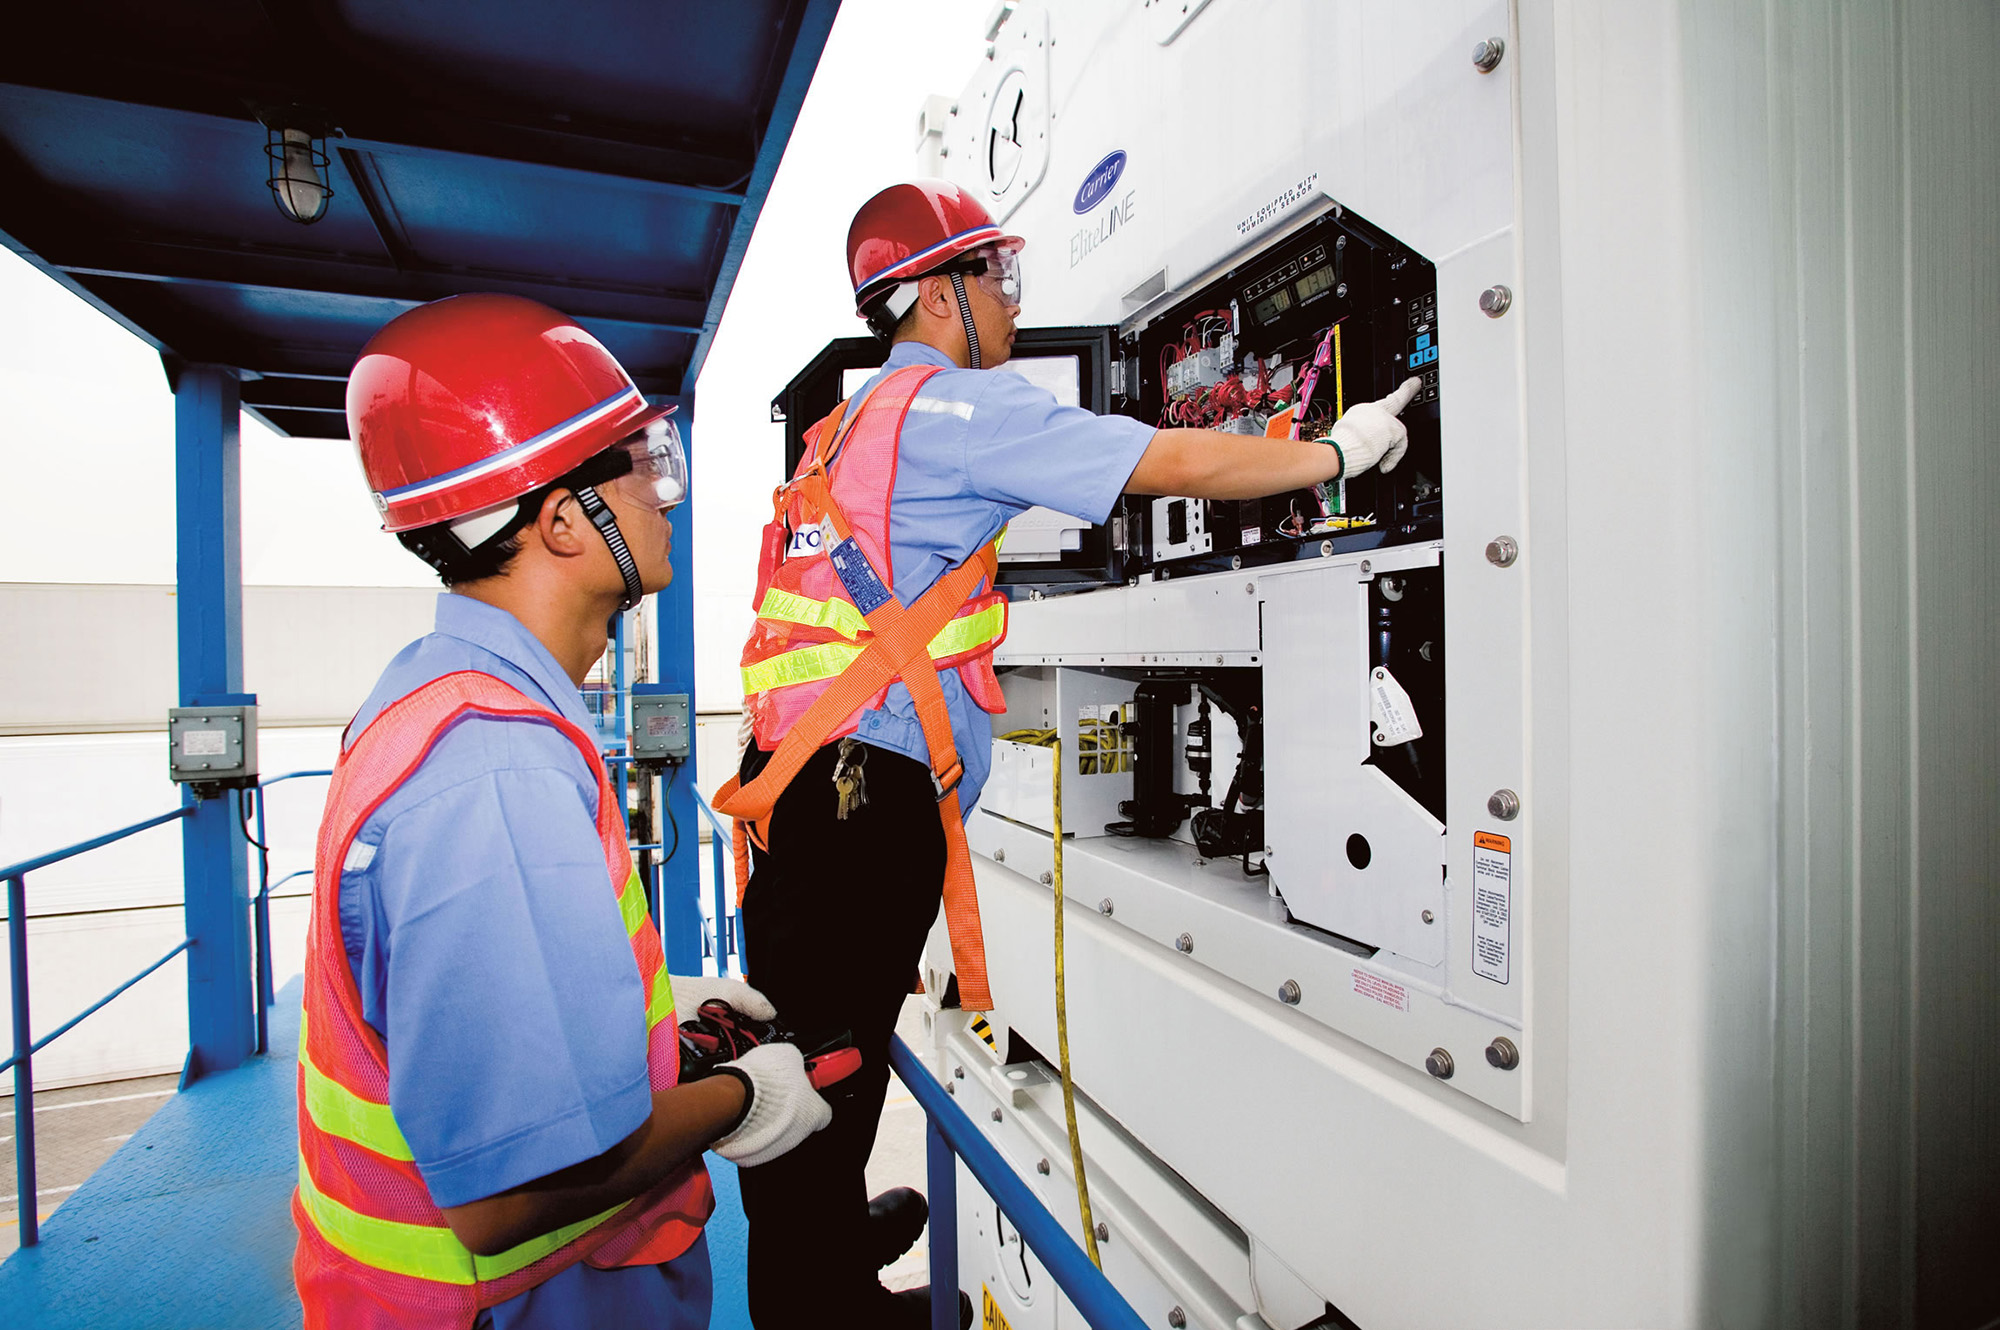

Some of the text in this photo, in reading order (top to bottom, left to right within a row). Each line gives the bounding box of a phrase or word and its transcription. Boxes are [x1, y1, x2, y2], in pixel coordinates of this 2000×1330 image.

[1080, 159, 1120, 203] Carrier
[1236, 172, 1318, 231] UNIT EQUIPPED WITH
[1069, 189, 1136, 269] EliteLINE
[1241, 183, 1312, 235] HUMIDITY SENSOR
[983, 1289, 1010, 1330] CAUT
